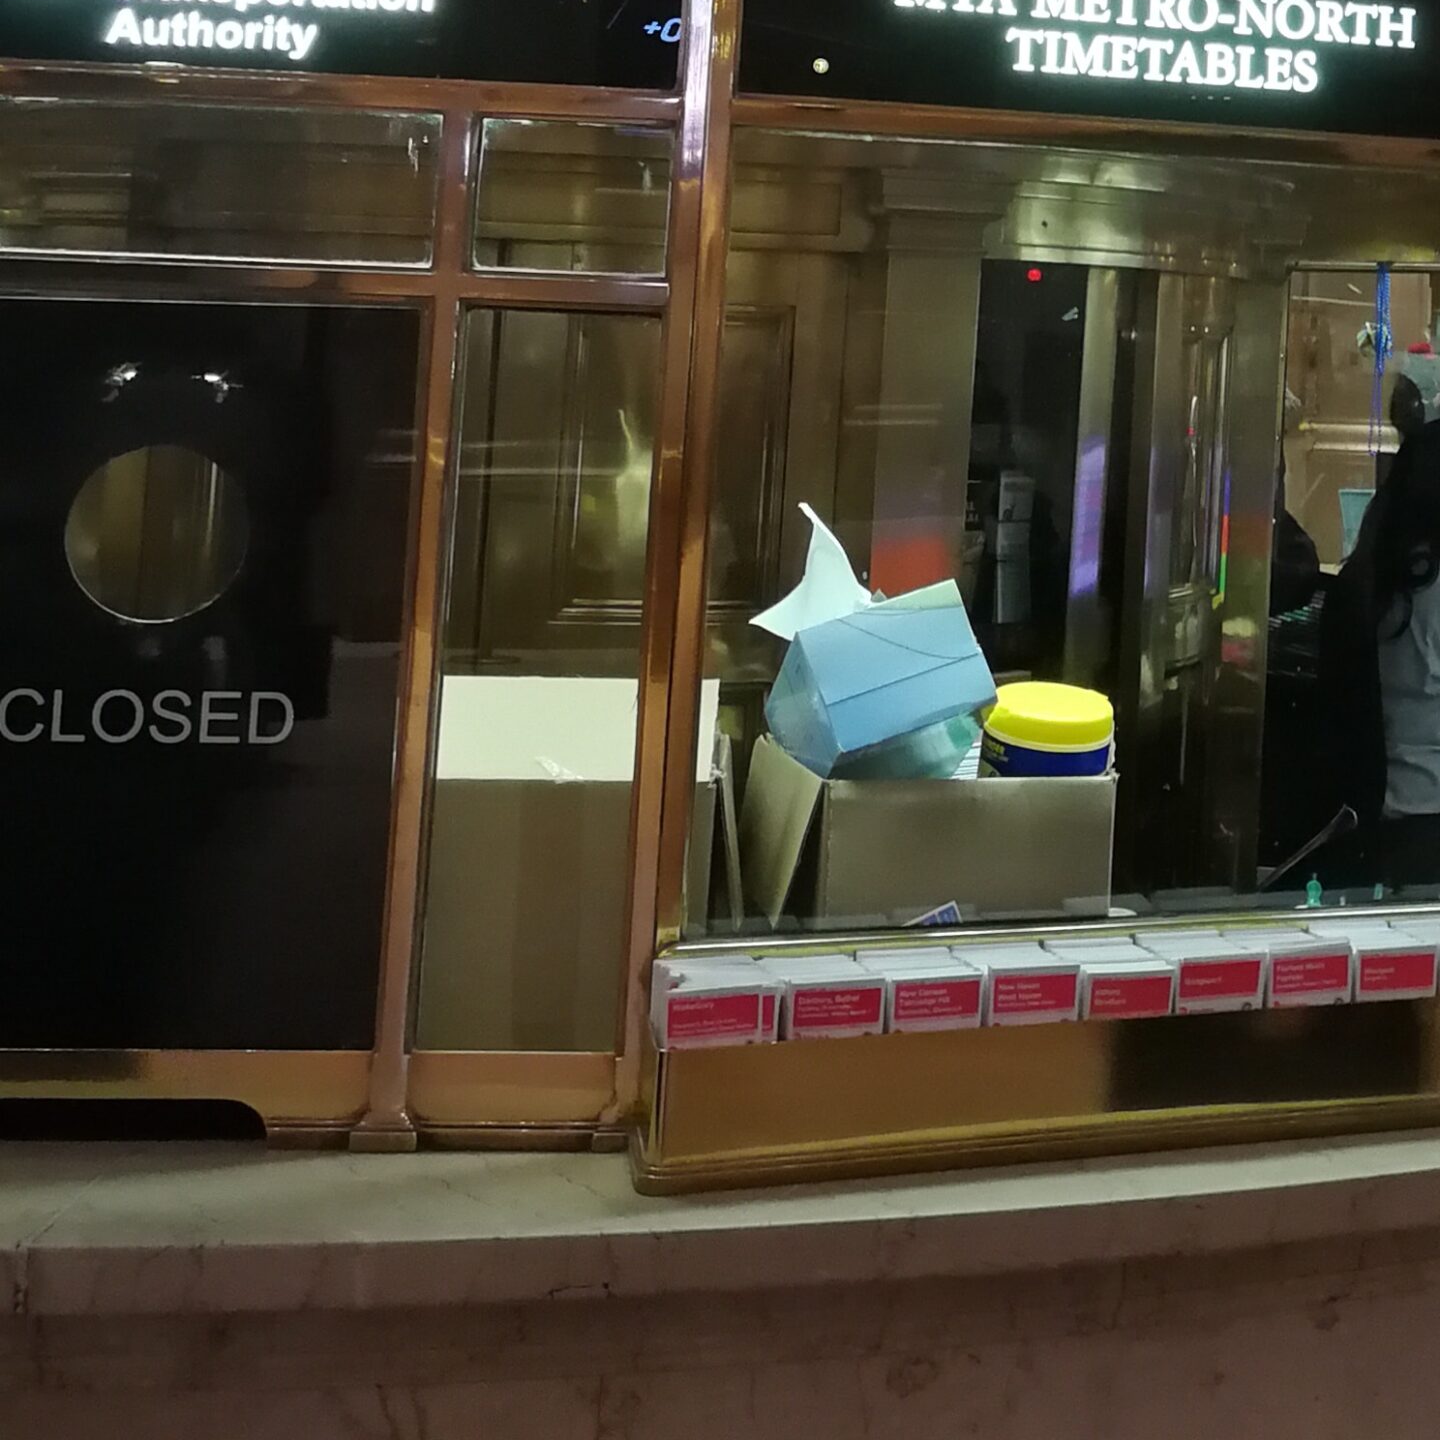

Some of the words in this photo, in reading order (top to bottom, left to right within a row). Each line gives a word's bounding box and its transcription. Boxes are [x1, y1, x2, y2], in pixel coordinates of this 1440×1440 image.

[104, 12, 319, 60] Authority
[1005, 27, 1319, 93] TIMETABLES
[0, 688, 294, 743] CLOSED
